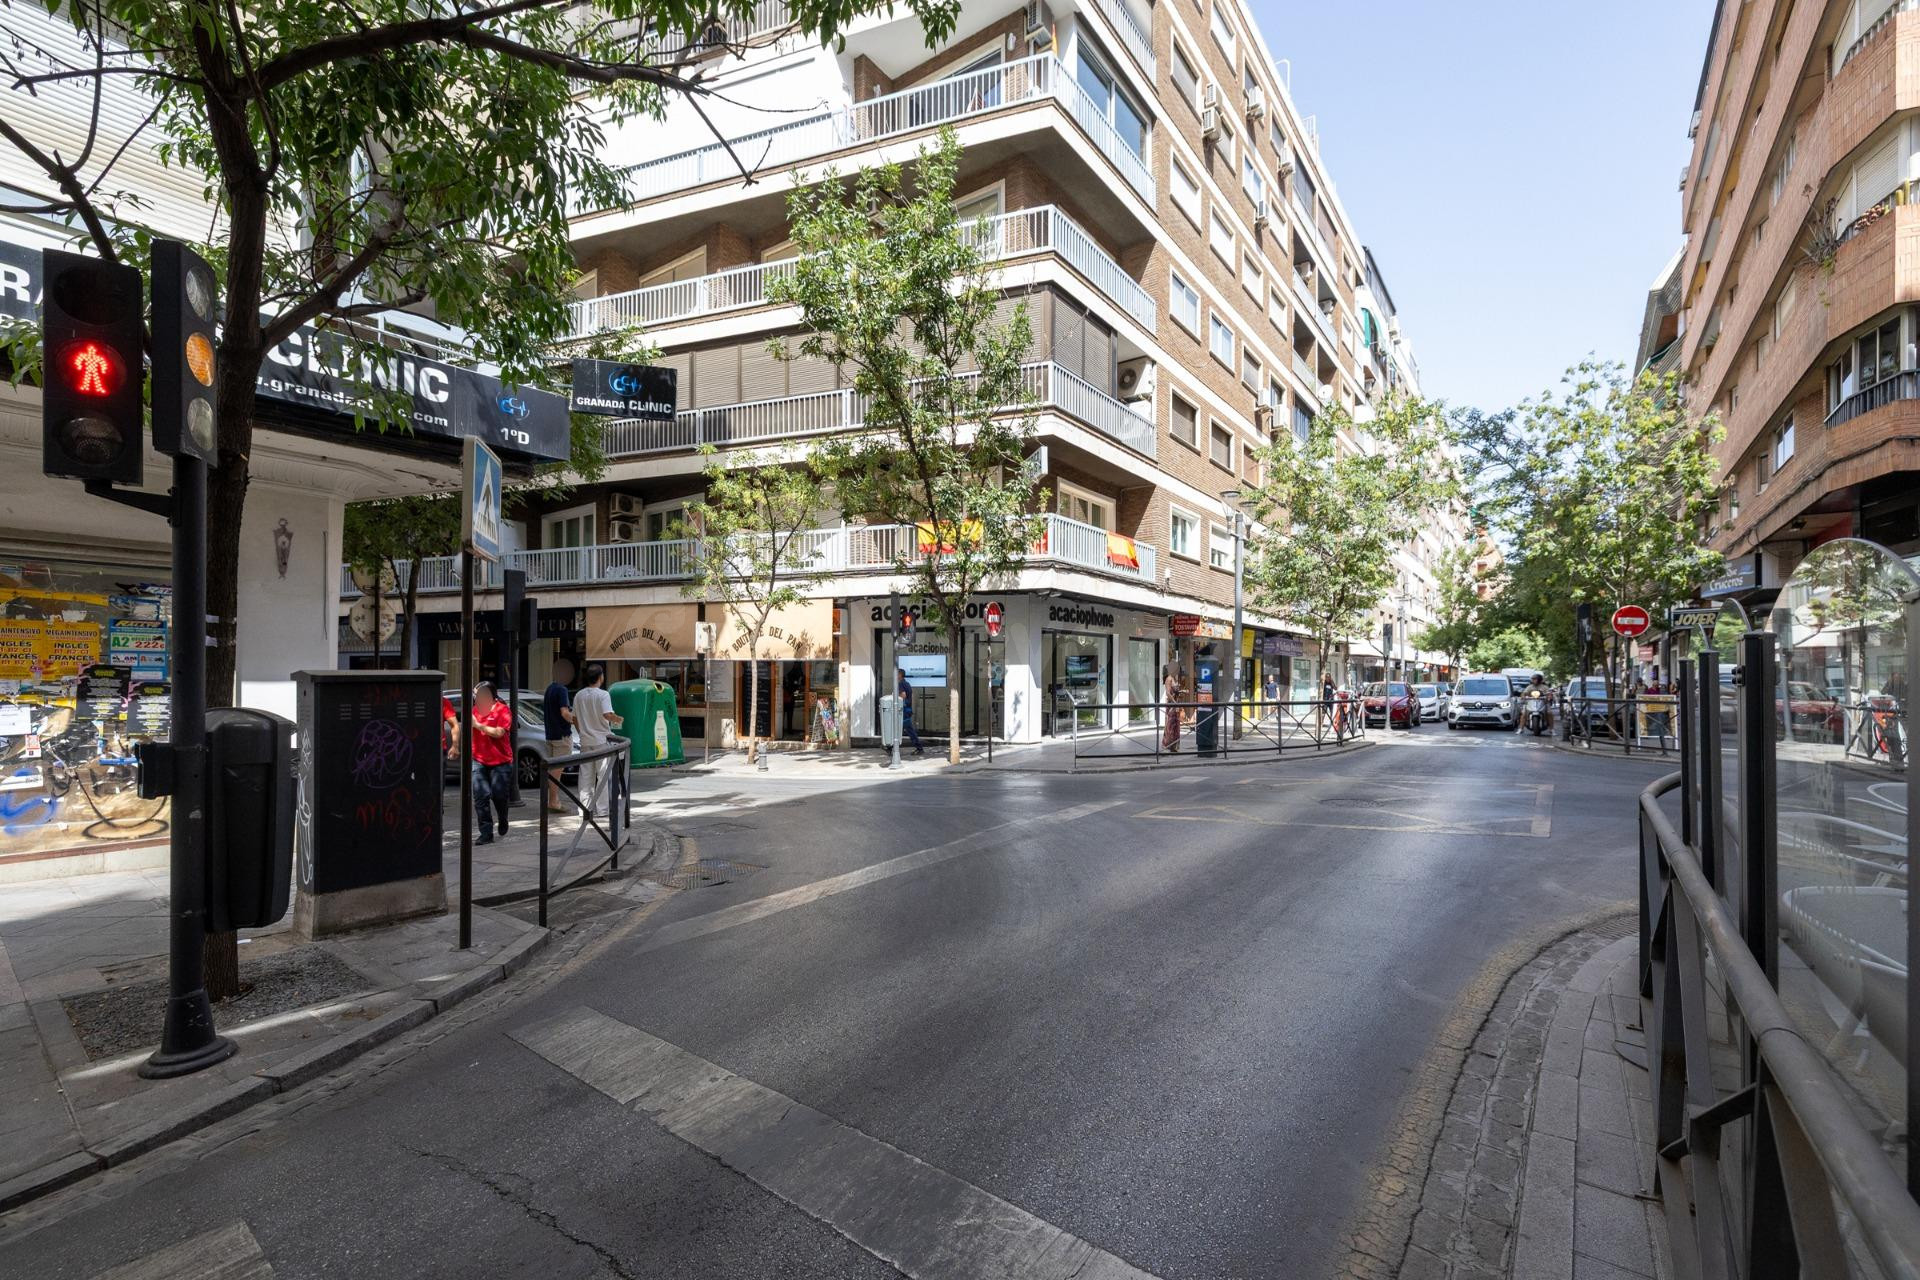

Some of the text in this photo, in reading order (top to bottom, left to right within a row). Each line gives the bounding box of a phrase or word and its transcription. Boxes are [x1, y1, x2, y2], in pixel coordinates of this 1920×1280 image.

[576, 396, 672, 414] GRANADA CLINIC
[1049, 604, 1114, 629] acaciophone
[609, 627, 672, 653] BOUTIQUE DEL PAN
[731, 626, 804, 652] BOUTE DEL PAN
[1201, 668, 1210, 680] P
